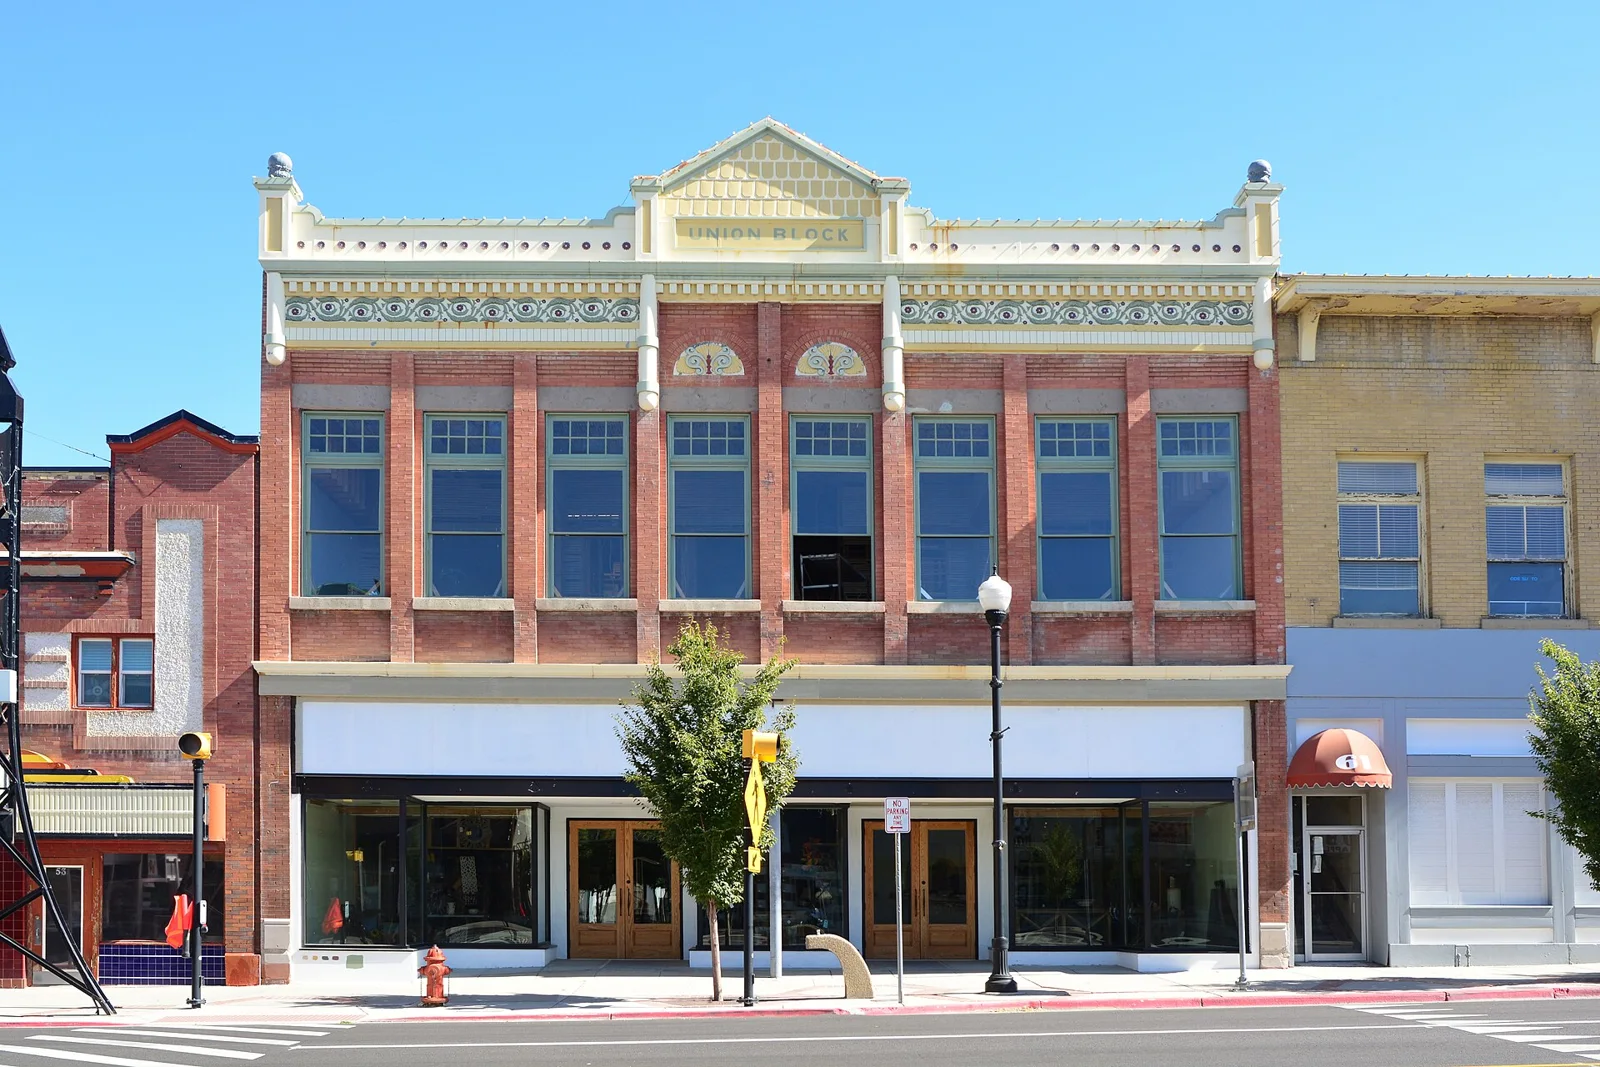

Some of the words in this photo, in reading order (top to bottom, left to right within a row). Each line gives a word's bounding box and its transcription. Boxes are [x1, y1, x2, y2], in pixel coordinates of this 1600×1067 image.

[689, 227, 760, 241] UNION
[773, 228, 848, 242] BLOCK
[887, 807, 908, 815] PARKING
